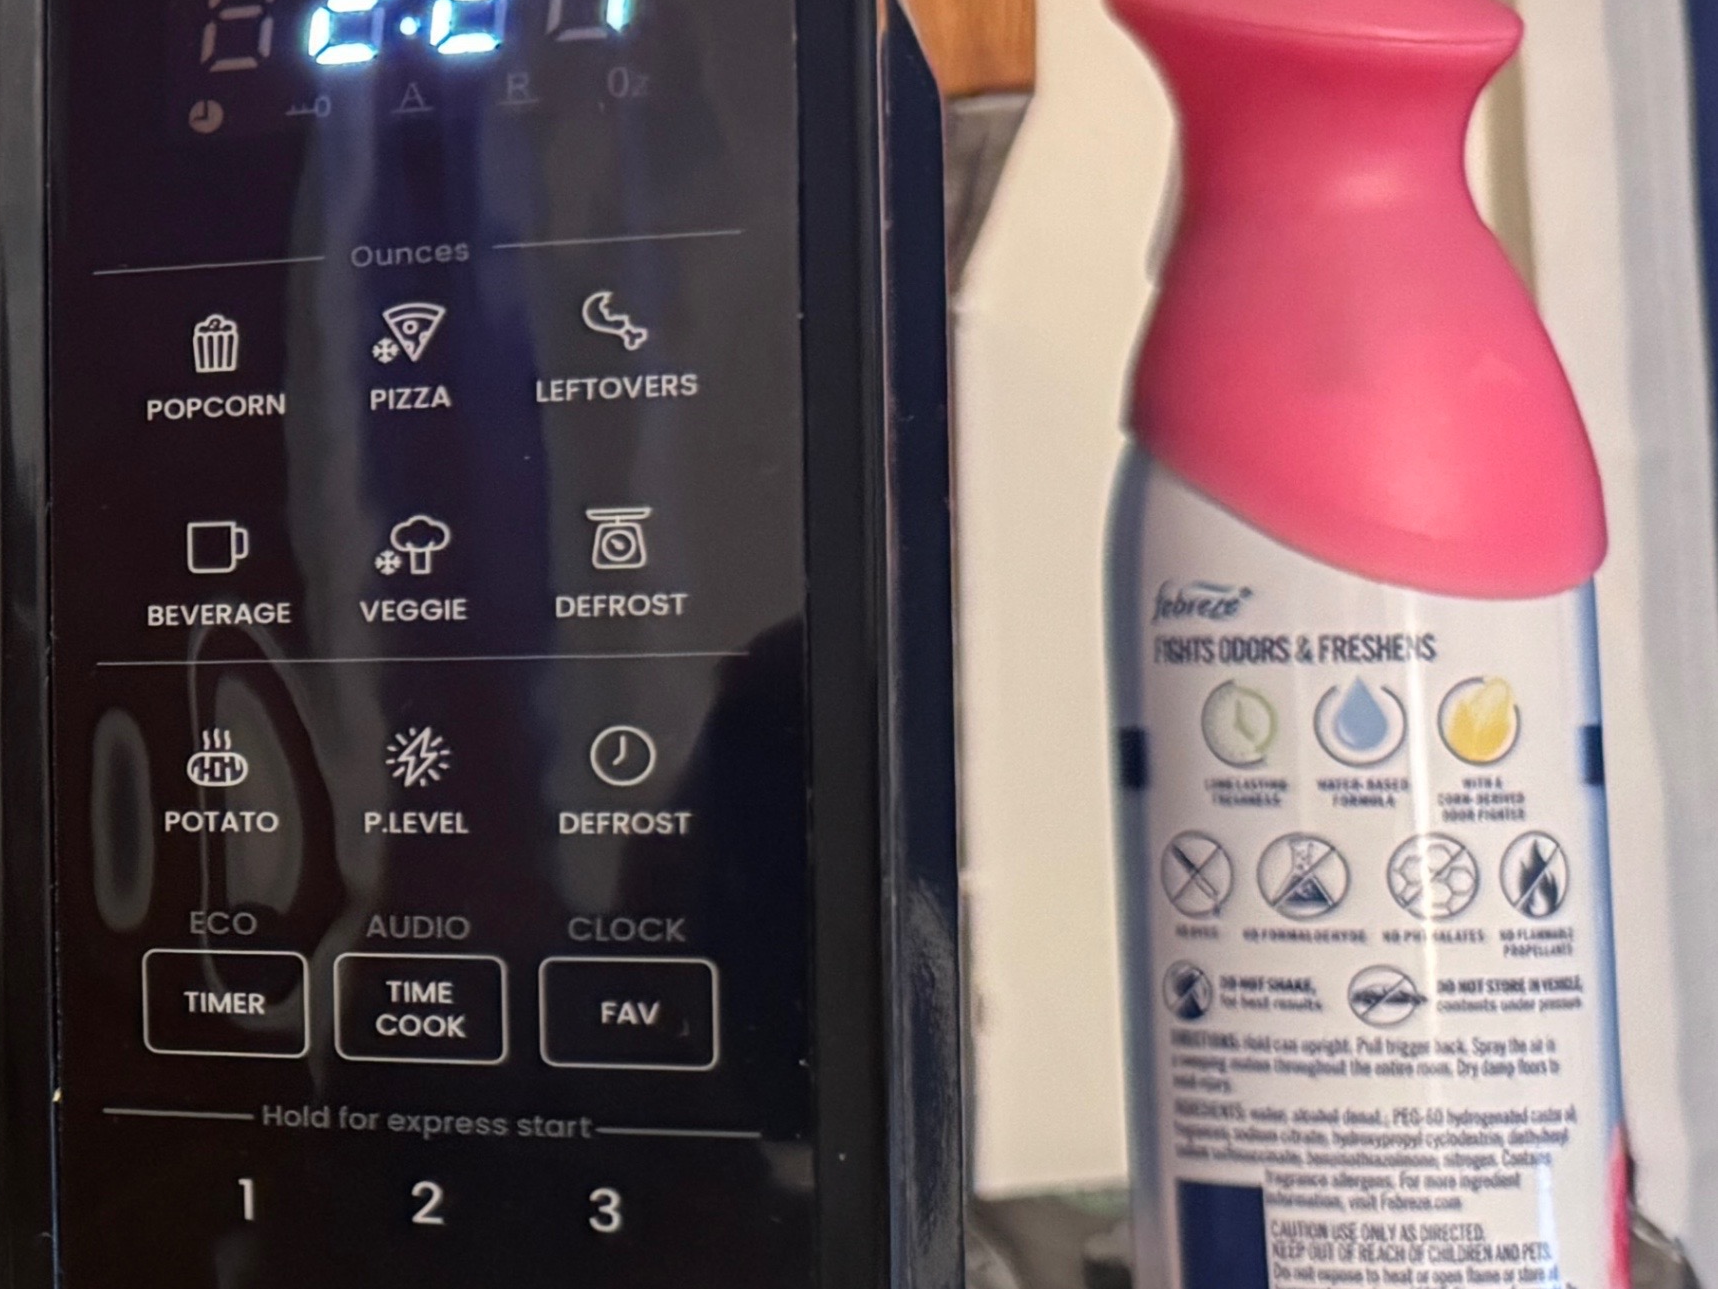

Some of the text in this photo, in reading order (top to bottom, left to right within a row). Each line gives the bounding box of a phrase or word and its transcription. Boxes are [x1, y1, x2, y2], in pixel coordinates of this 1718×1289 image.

[351, 243, 469, 267] Ounces
[371, 386, 451, 410] PIZZA
[536, 374, 697, 402] LEFTOVERS
[147, 393, 285, 420] POPCORN
[148, 603, 290, 626] BEVERAGE
[360, 598, 466, 622] VEGGIE
[556, 593, 687, 617] DEFROST
[1220, 634, 1290, 662] ODORS
[1295, 636, 1312, 662] &
[1318, 633, 1437, 661] FRESHENS
[165, 811, 279, 832] POTATO
[365, 812, 468, 834] P.LEVEL
[559, 812, 691, 834] DEFROST
[189, 911, 257, 937] ECO
[366, 915, 470, 940] AUDIO
[568, 917, 685, 942] CLOCK
[184, 991, 265, 1014] TIMER
[386, 981, 452, 1004] TIME
[601, 1001, 659, 1024] FAV
[376, 1014, 465, 1037] COOK
[263, 1105, 591, 1140] Hold for express start
[239, 1179, 253, 1220] 1
[412, 1181, 443, 1224] 2
[590, 1188, 621, 1232] 3
